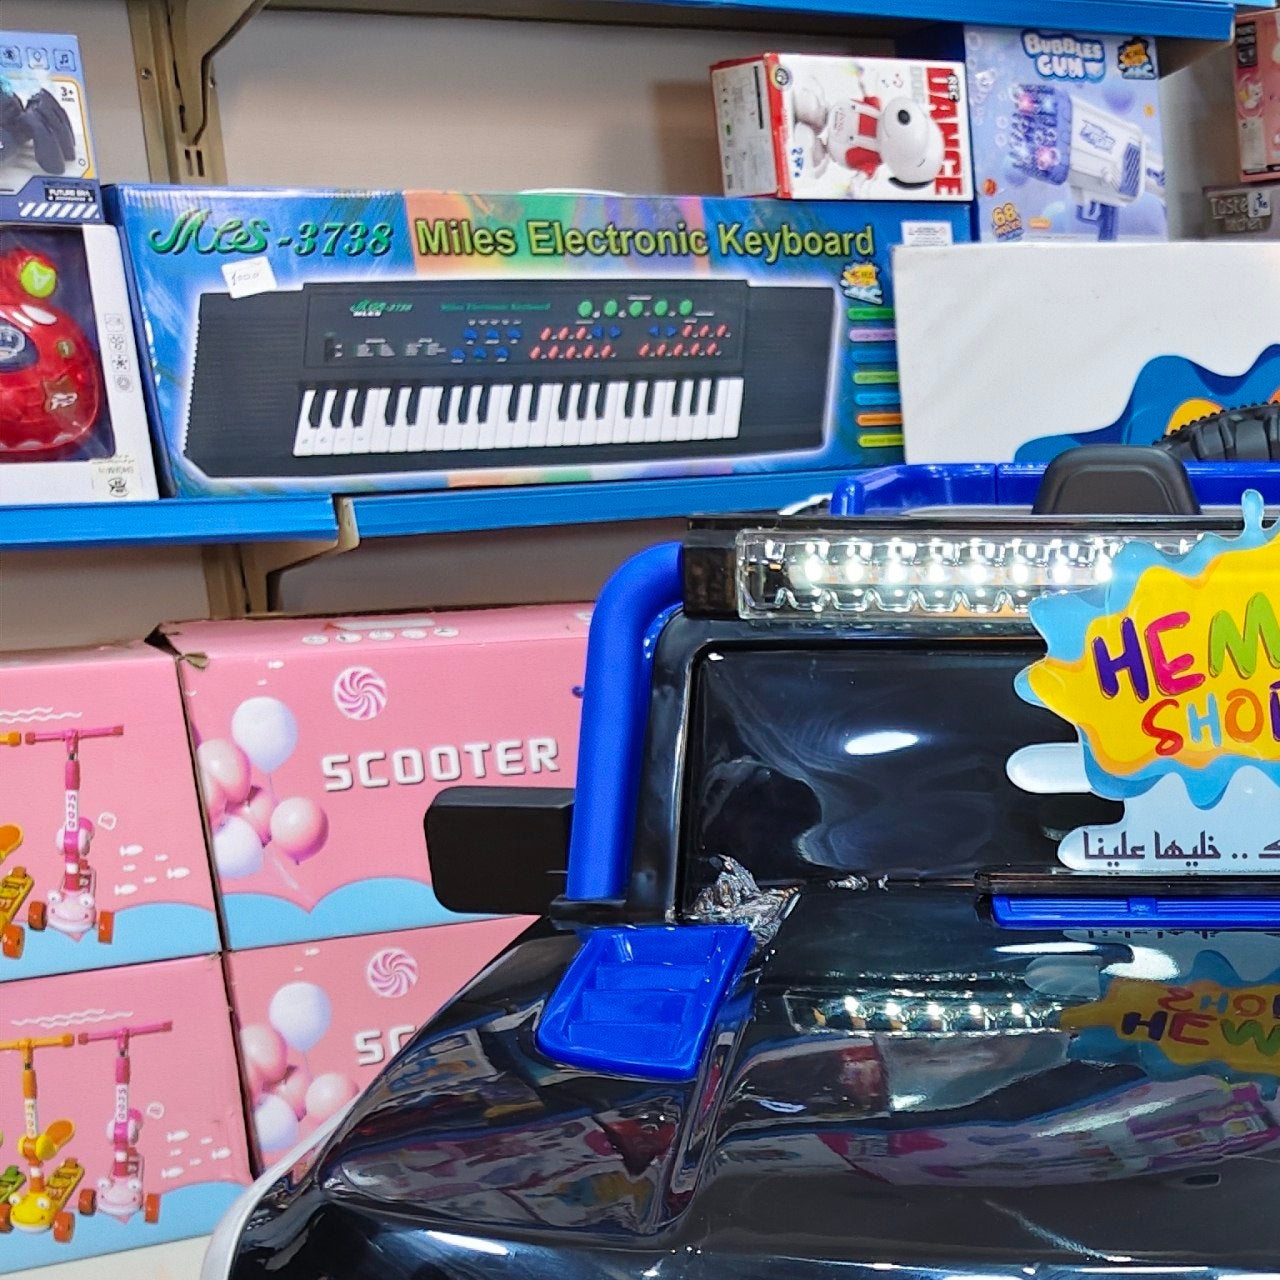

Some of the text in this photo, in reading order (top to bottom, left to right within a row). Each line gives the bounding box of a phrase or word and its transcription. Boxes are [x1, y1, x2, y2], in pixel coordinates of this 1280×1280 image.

[1024, 33, 1103, 60] BUBBLES
[1037, 55, 1086, 79] GUM
[415, 218, 517, 257] Miles
[527, 220, 709, 258] Electronic
[717, 222, 875, 264] Keyboard
[321, 737, 561, 792] SCOOTER
[1083, 829, 1146, 867] علينا
[1154, 829, 1222, 867] خليها
